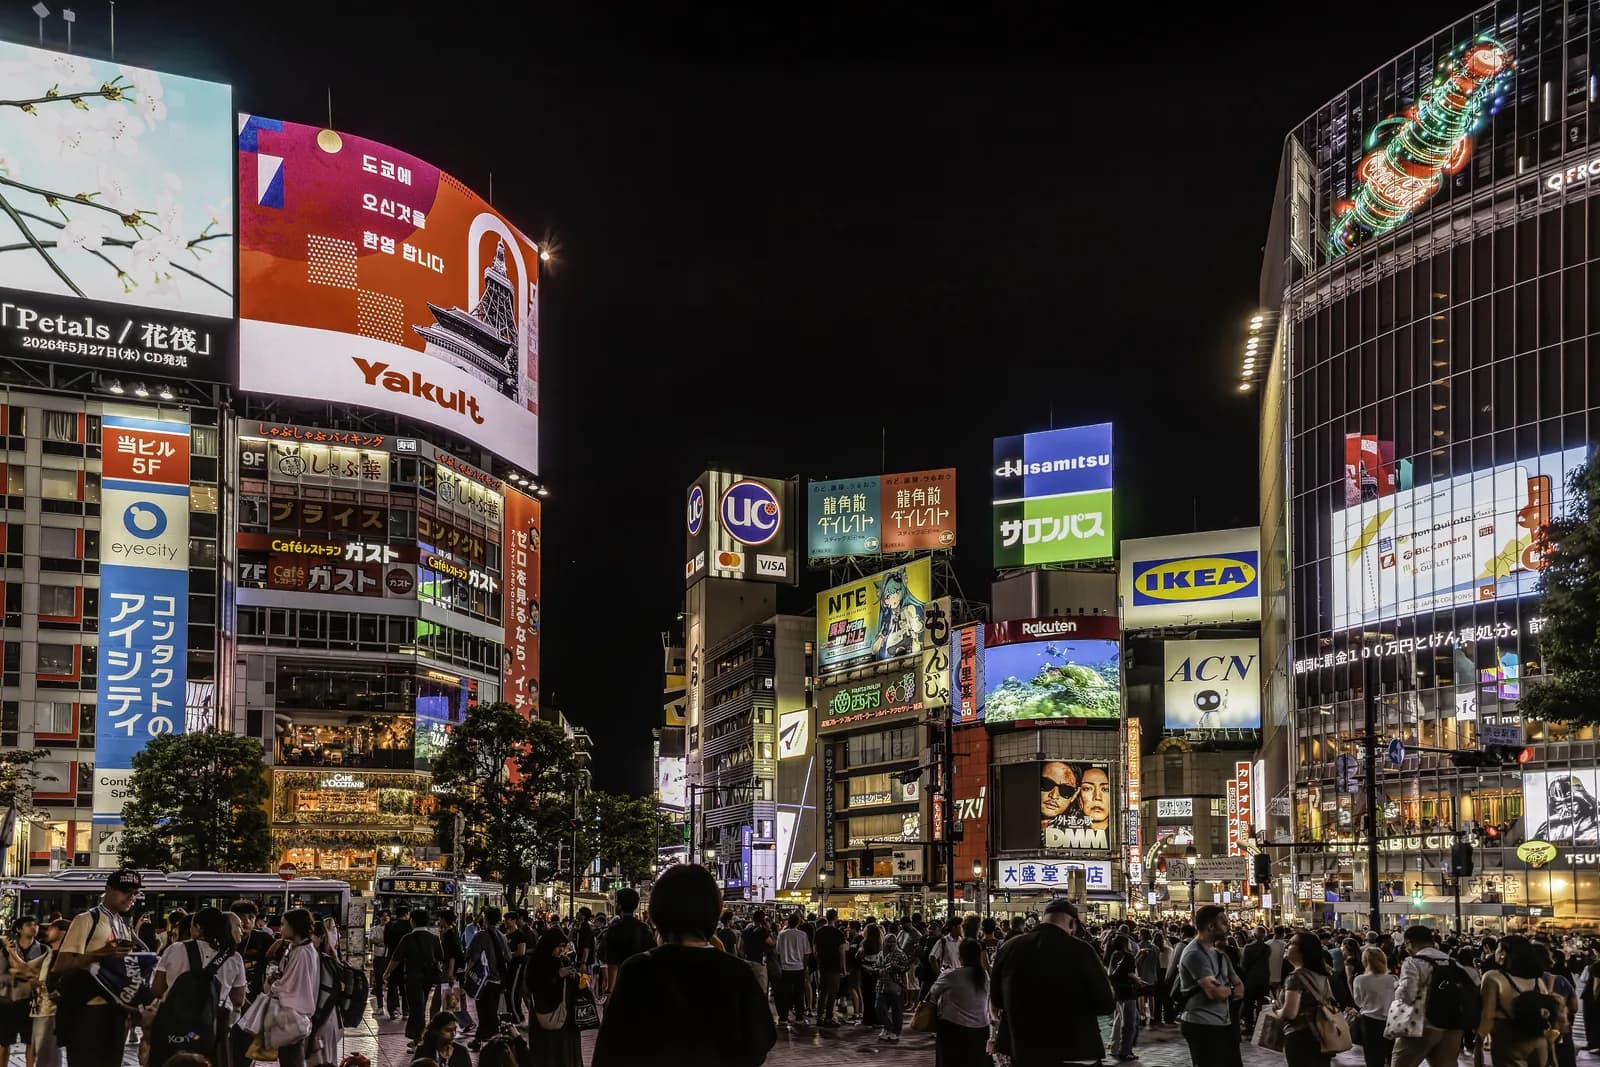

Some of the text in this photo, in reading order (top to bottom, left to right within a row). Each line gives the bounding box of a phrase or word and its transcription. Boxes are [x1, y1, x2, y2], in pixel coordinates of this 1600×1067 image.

[362, 154, 412, 186] 도쿄에
[362, 194, 426, 230] 오신것을
[363, 231, 444, 274] 환영 합니다
[144, 351, 188, 367] CD発売
[352, 357, 485, 426] Yakult
[117, 435, 175, 458] 当ビル
[259, 423, 385, 448] しゃぶしゃぶバイキング
[132, 458, 162, 476] 5F
[242, 452, 265, 467] 9F
[311, 454, 381, 480] しゃぶ葉
[995, 454, 1110, 477] Hisamitsu
[459, 485, 498, 519] しゃぶ葉
[824, 493, 866, 515] 龍角散
[897, 486, 941, 508] 龍角散
[272, 502, 383, 529] プライス
[818, 514, 875, 535] ダイレクト
[891, 508, 950, 529] ダイレクト
[418, 516, 484, 559] コンタクト
[1000, 511, 1104, 547] サロンパス
[111, 542, 178, 561] eyecity
[272, 539, 399, 563] Caféレストラン ガスト
[1415, 535, 1468, 556] BicCamera
[240, 563, 267, 580] 7F
[273, 565, 304, 578] Café
[758, 559, 785, 572] VISA
[308, 567, 376, 592] ガスト
[469, 569, 498, 593] ガスト
[1145, 566, 1248, 592] IKEA
[828, 586, 867, 616] NTE
[1022, 621, 1077, 637] Rakuten
[108, 592, 145, 736] アイシティ
[924, 601, 951, 703] もんじゃ
[148, 595, 175, 737] コンタクトの
[960, 631, 973, 717] 三千里薬品
[1168, 655, 1256, 682] ACN
[851, 690, 880, 711] 西村
[1239, 769, 1249, 817] カラオケ
[1160, 808, 1192, 816] クリニック
[1046, 827, 1109, 849] DMM
